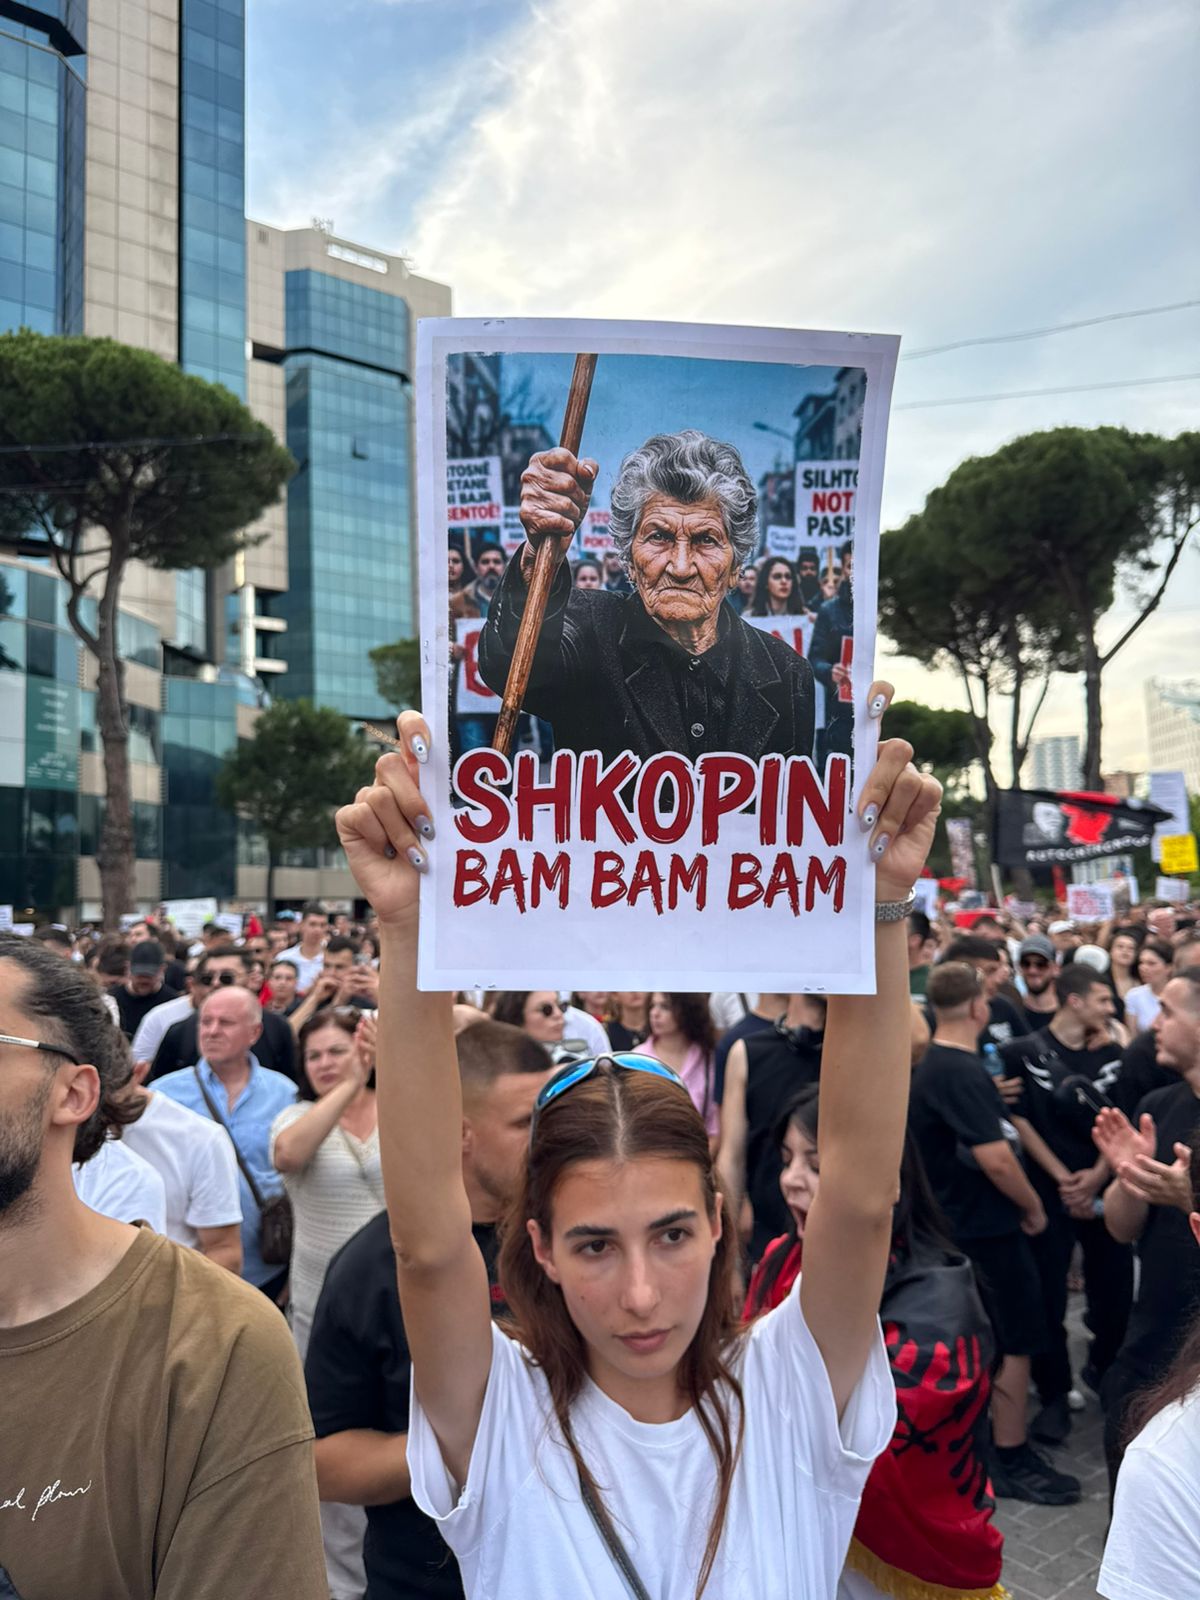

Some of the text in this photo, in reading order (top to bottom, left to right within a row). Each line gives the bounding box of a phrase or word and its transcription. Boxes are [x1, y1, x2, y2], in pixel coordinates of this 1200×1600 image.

[812, 491, 854, 513] NOT
[454, 751, 847, 846] SHKOPIN
[453, 849, 847, 916] BAM BAM BAM
